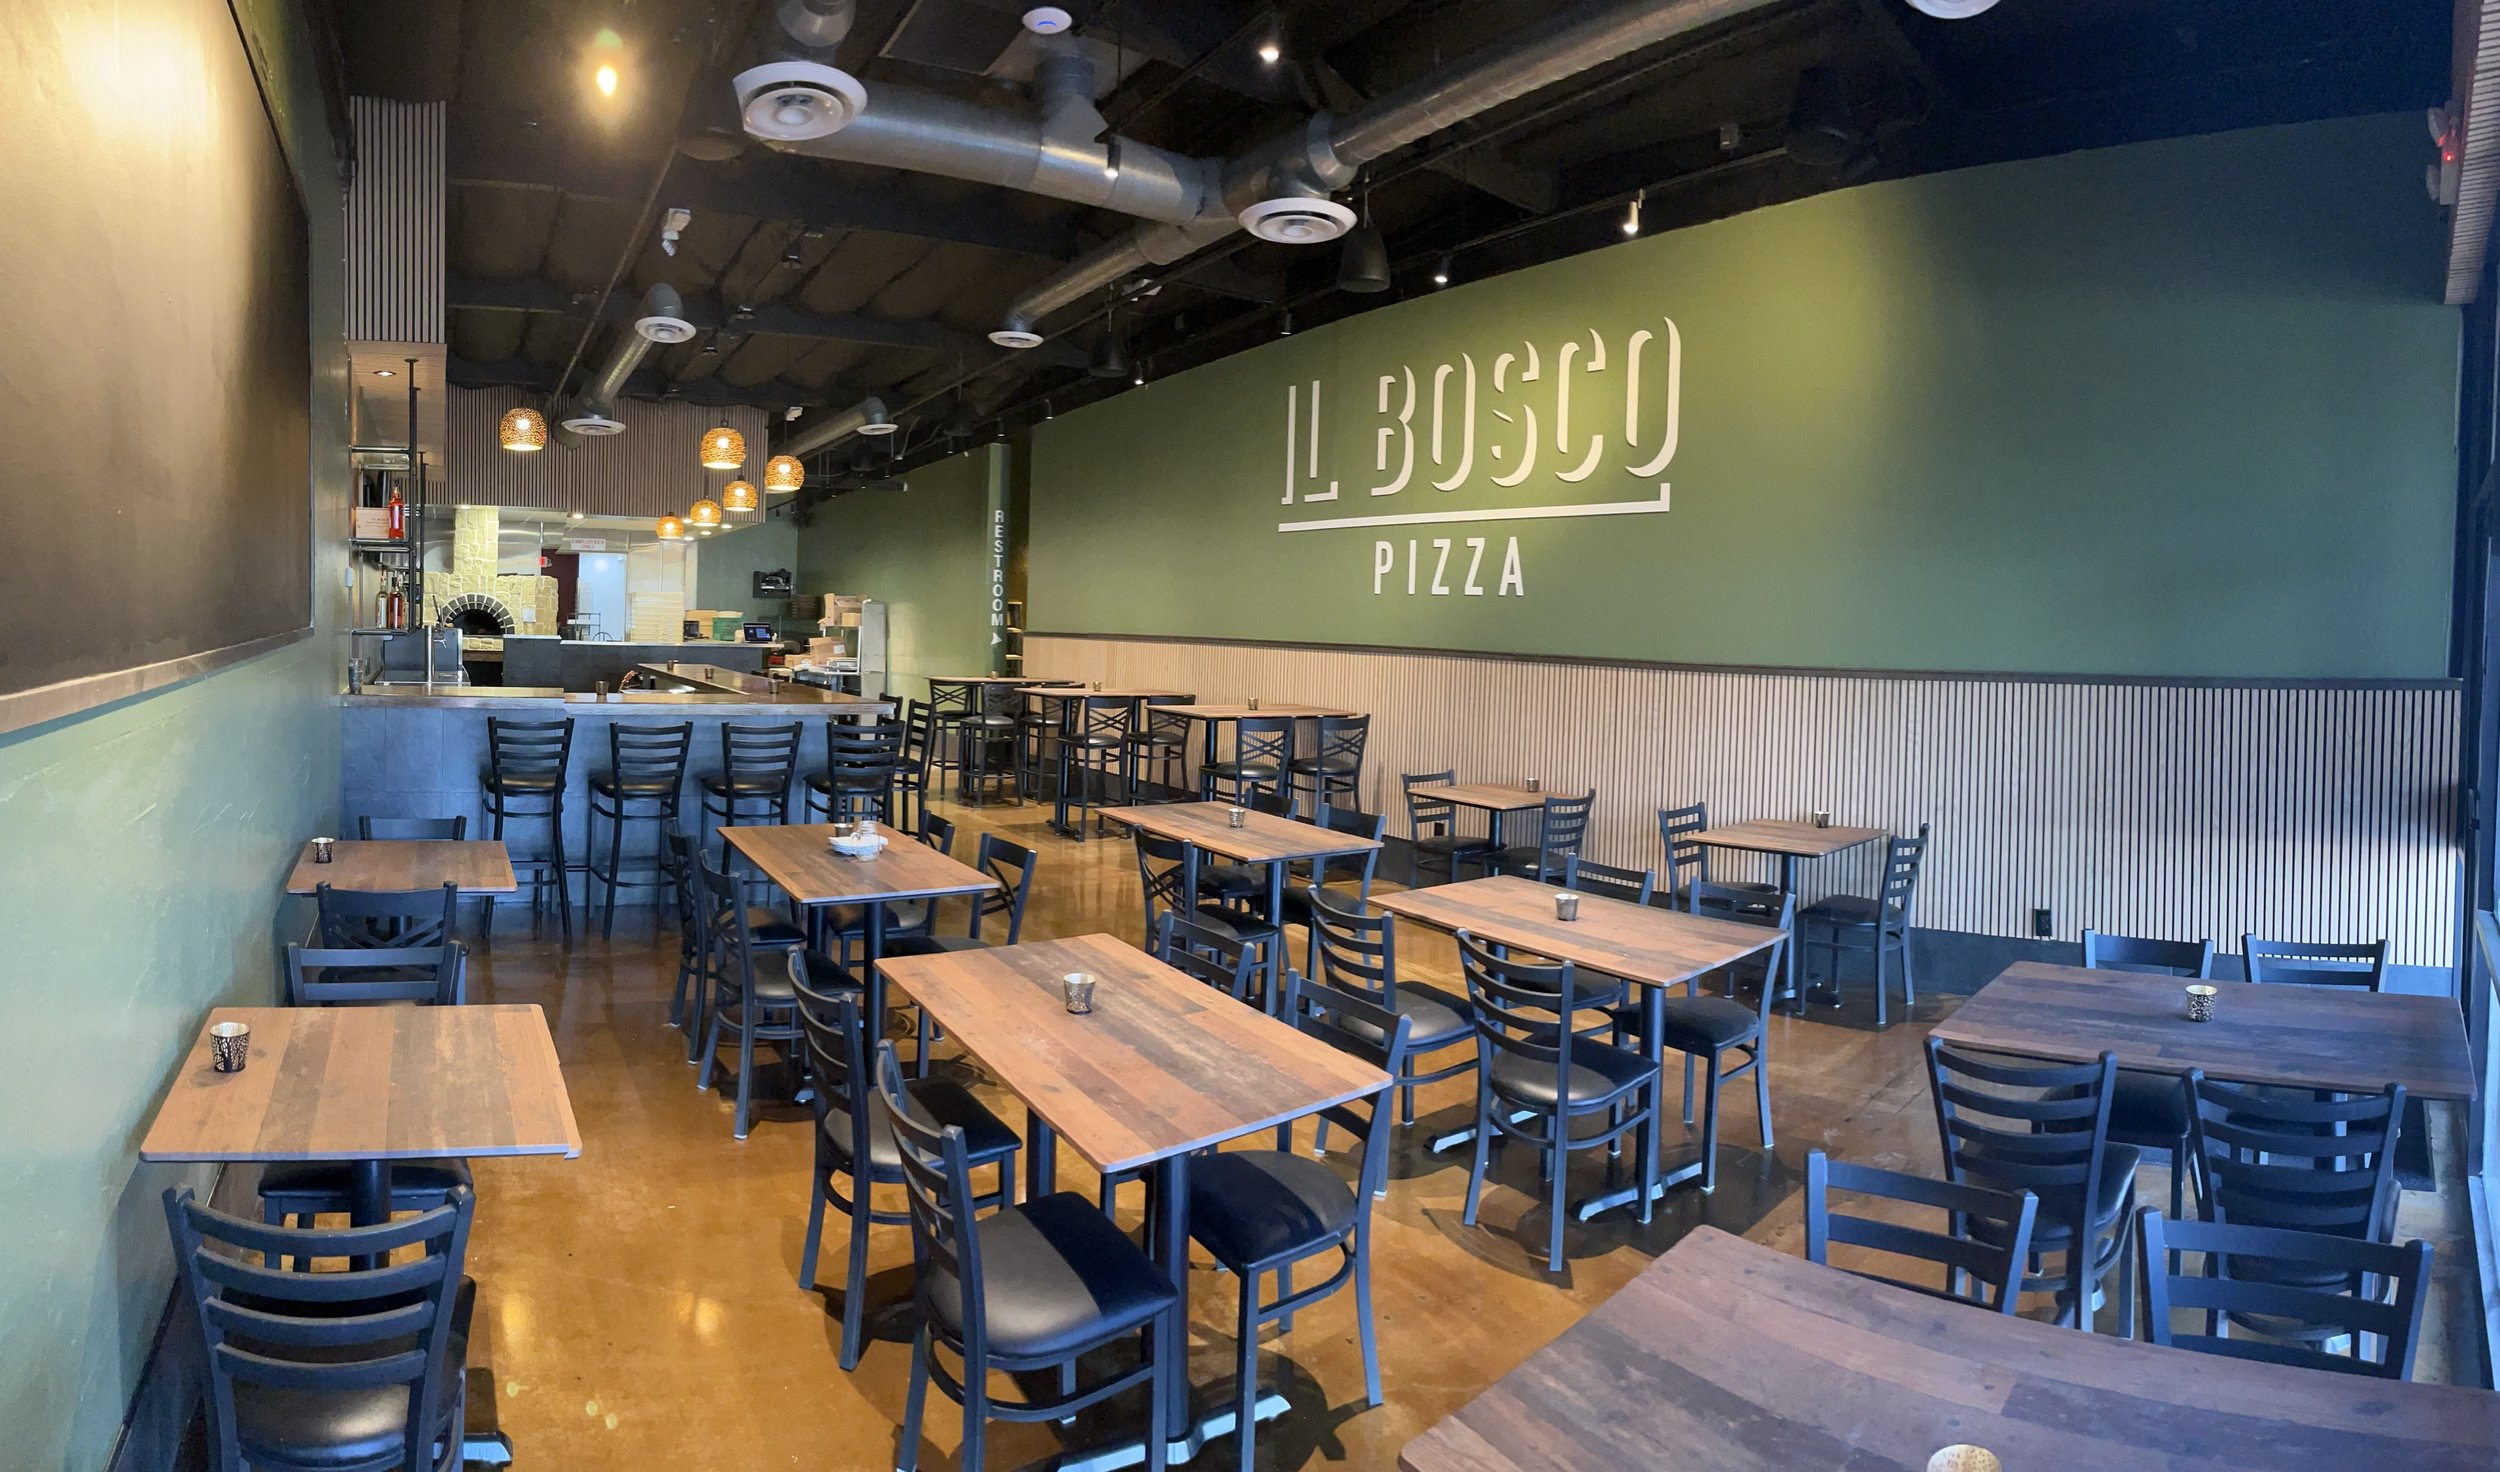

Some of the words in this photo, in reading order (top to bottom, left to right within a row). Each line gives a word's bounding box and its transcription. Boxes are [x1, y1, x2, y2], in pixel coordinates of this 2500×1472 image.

[1281, 380, 1338, 505] IL
[1371, 316, 1681, 497] BOSCO
[991, 509, 1004, 626] RESTROOM
[1374, 537, 1524, 597] PIZZA
